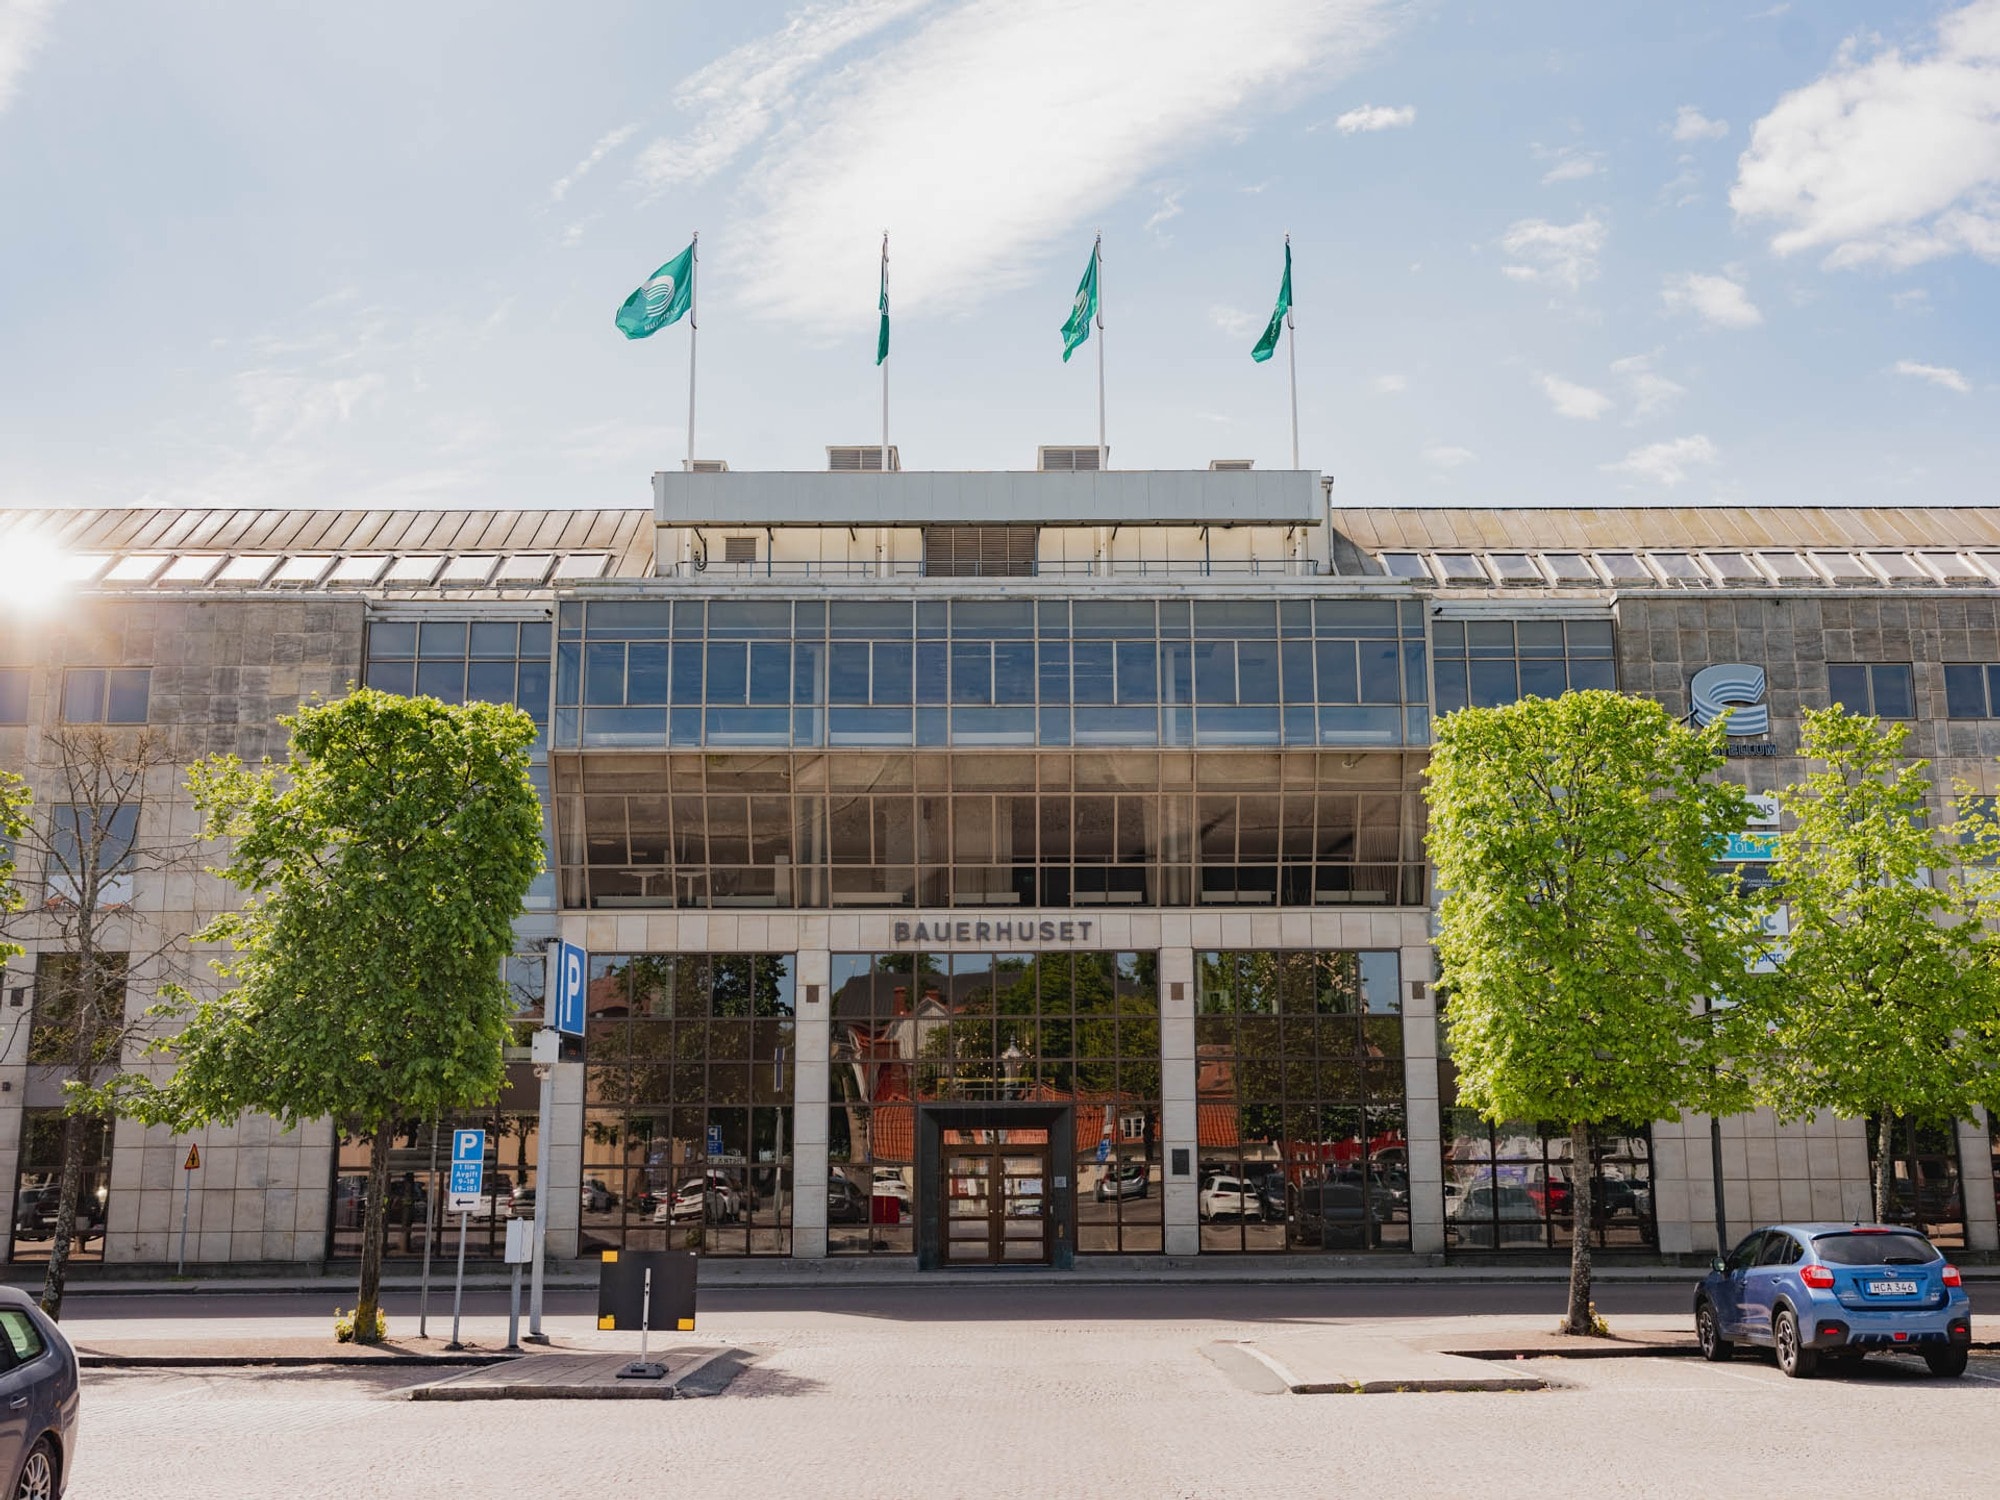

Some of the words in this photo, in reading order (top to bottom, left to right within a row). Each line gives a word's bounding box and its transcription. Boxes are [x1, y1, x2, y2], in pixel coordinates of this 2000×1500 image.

[1711, 743, 1777, 756] STELLUM
[894, 921, 1092, 942] BAUERHUSET
[567, 953, 580, 1022] P
[459, 1133, 478, 1158] P
[1873, 1283, 1893, 1292] HCA
[1895, 1282, 1914, 1292] 346
